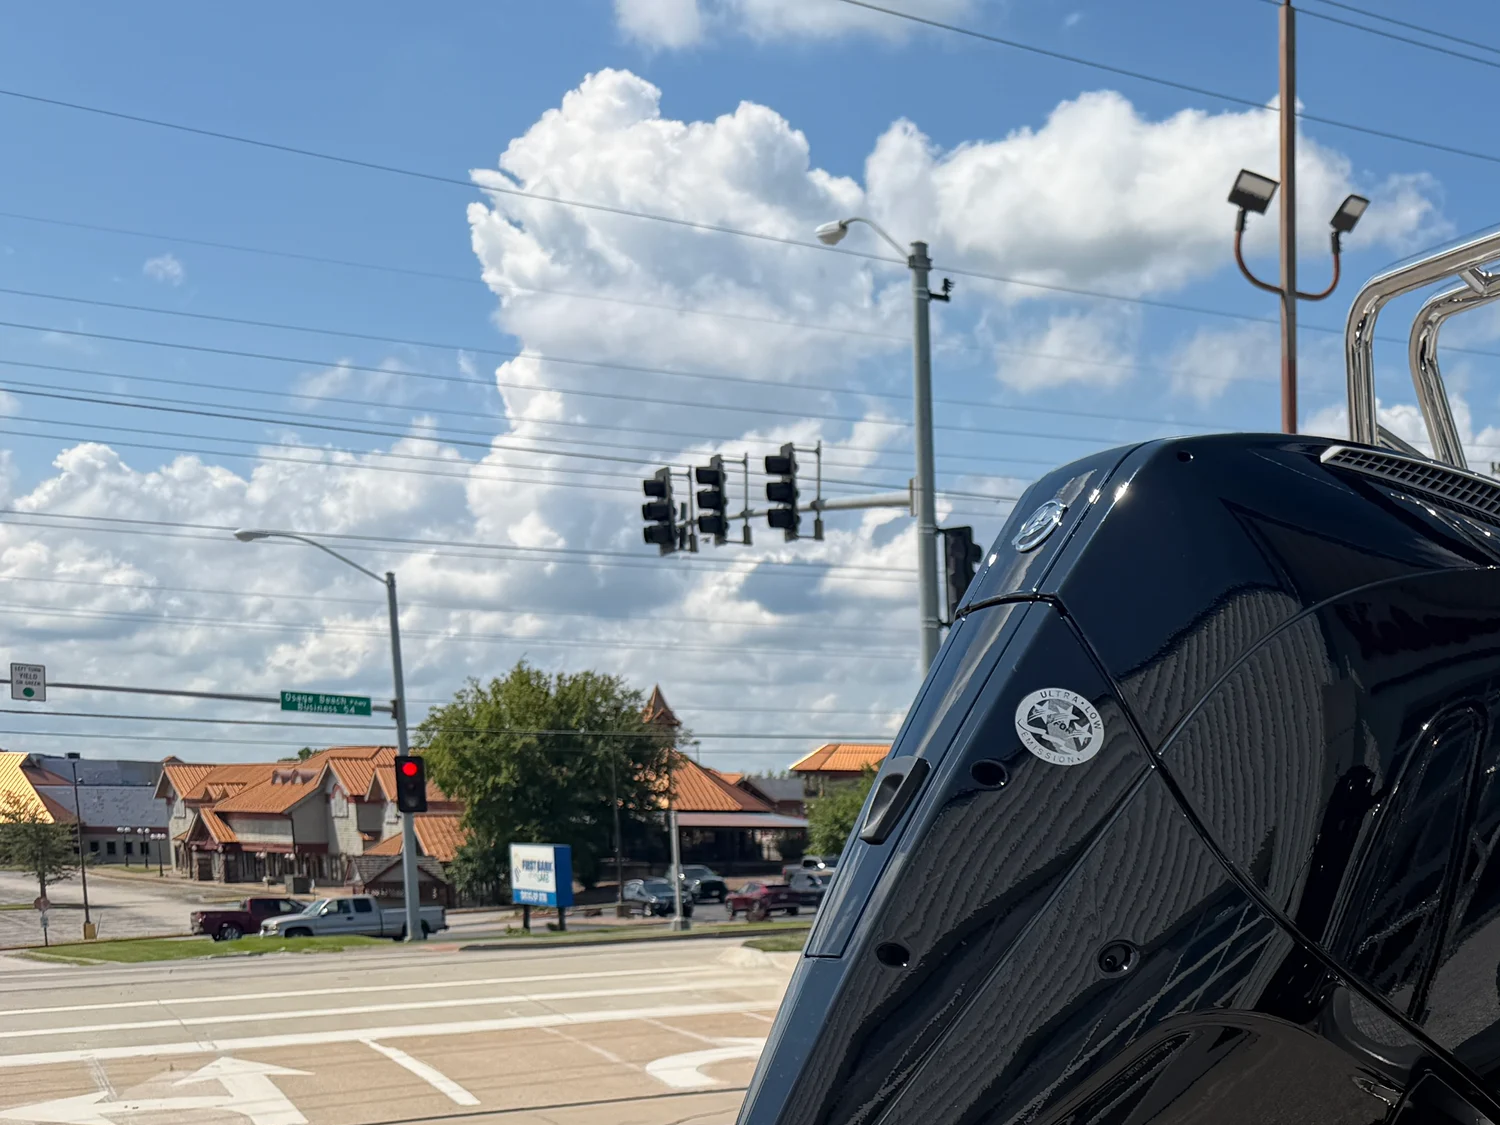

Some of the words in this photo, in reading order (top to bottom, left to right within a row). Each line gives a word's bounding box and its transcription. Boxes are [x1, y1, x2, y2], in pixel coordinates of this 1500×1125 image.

[20, 672, 38, 680] YIELD
[285, 692, 314, 704] Osage
[319, 695, 347, 706] Beach
[1040, 690, 1079, 703] ULTRA
[297, 703, 338, 713] Business
[1085, 705, 1102, 730] LOW
[1020, 731, 1075, 763] EMISSION
[537, 860, 553, 872] BANK
